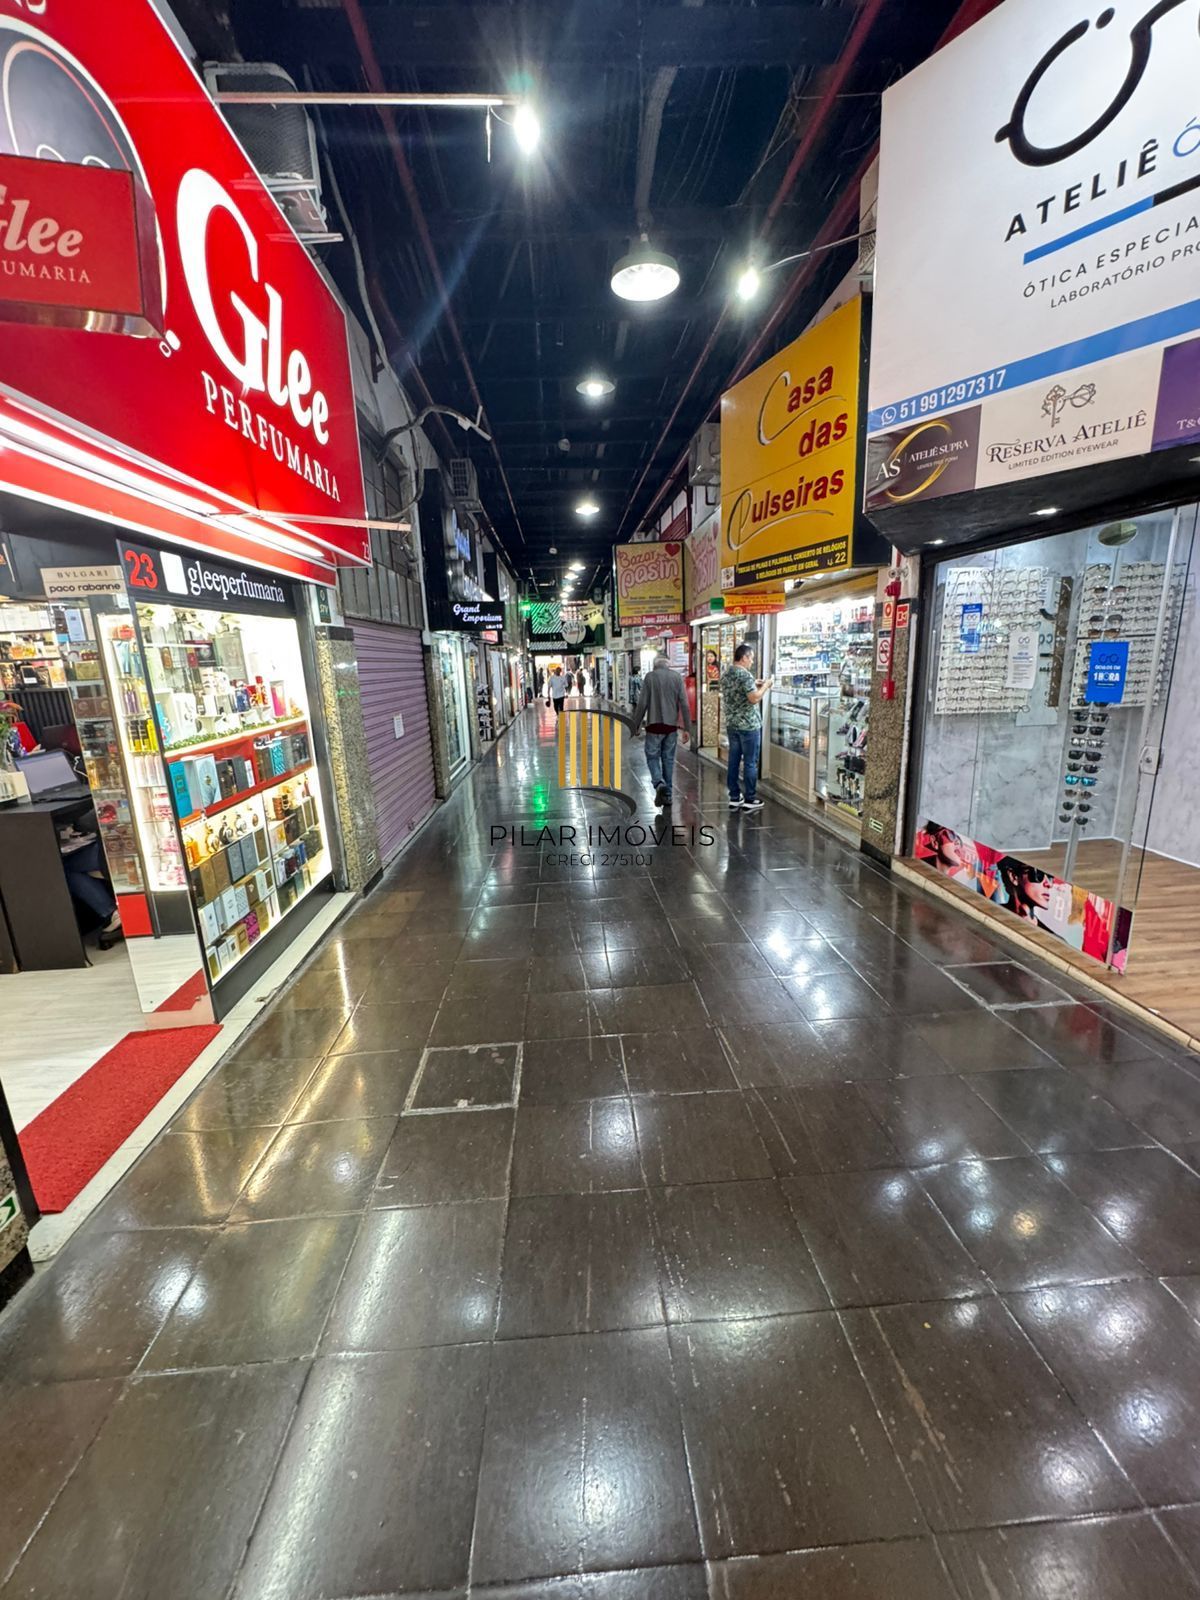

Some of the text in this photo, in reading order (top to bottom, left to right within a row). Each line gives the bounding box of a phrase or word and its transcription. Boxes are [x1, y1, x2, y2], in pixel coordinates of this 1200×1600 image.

[1003, 138, 1160, 243] ATELIÊ
[1022, 262, 1087, 299] ÓTICA
[1050, 254, 1165, 309] LABORATÓRIO
[176, 168, 330, 445] Glee
[757, 365, 836, 446] Casa
[900, 368, 1007, 419] 51 991297317
[201, 370, 341, 503] PERFUMARIA
[798, 412, 849, 458] das
[985, 431, 1067, 464] RESERVA
[1072, 409, 1148, 442] ATELIÊ
[1176, 416, 1200, 431] T&
[876, 459, 901, 481] AS
[907, 446, 939, 464] ATELIÊ
[939, 440, 969, 455] SUPRA
[1008, 438, 1119, 470] LIMITED EDITION EYEWEAR
[727, 469, 845, 550] Pulseiras
[57, 569, 109, 580] BVLGARI
[125, 549, 159, 589] 23
[835, 551, 846, 564] 22
[49, 581, 121, 594] paco rabanne
[187, 560, 286, 603] gleeperfumaria
[453, 603, 480, 615] Grand
[462, 613, 503, 625] Emporium
